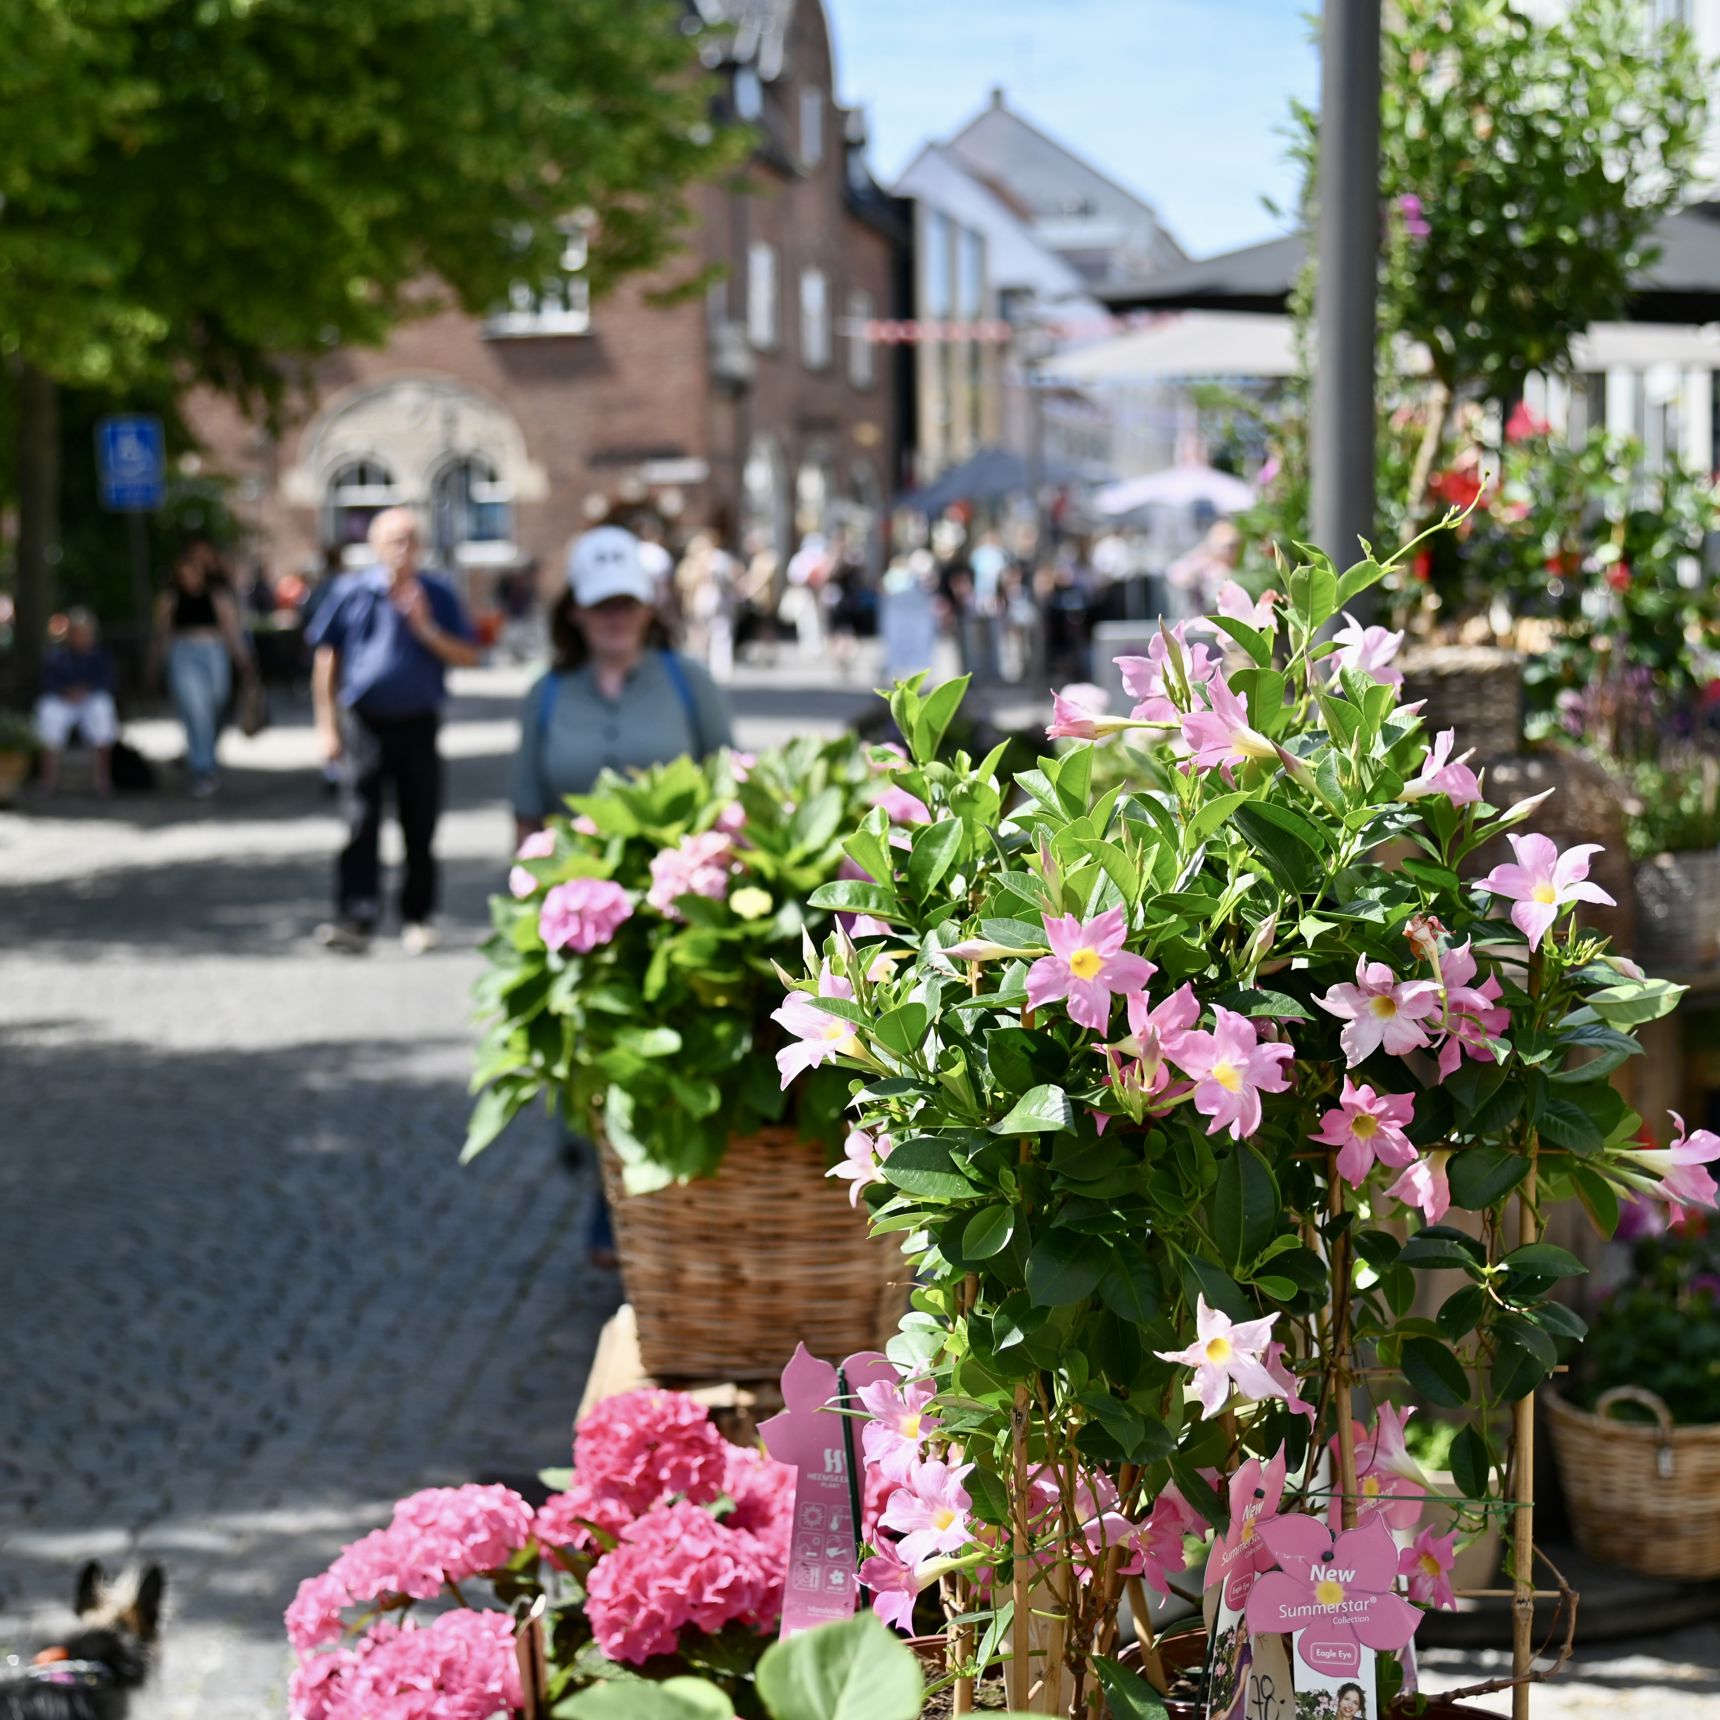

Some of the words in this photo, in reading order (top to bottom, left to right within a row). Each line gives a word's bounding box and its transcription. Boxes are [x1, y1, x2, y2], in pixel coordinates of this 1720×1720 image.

[1242, 1501, 1265, 1521] New
[1310, 1564, 1355, 1582] New
[1332, 1616, 1370, 1625] Collection
[1316, 1648, 1337, 1659] Eagle
[1338, 1650, 1352, 1660] Eye
